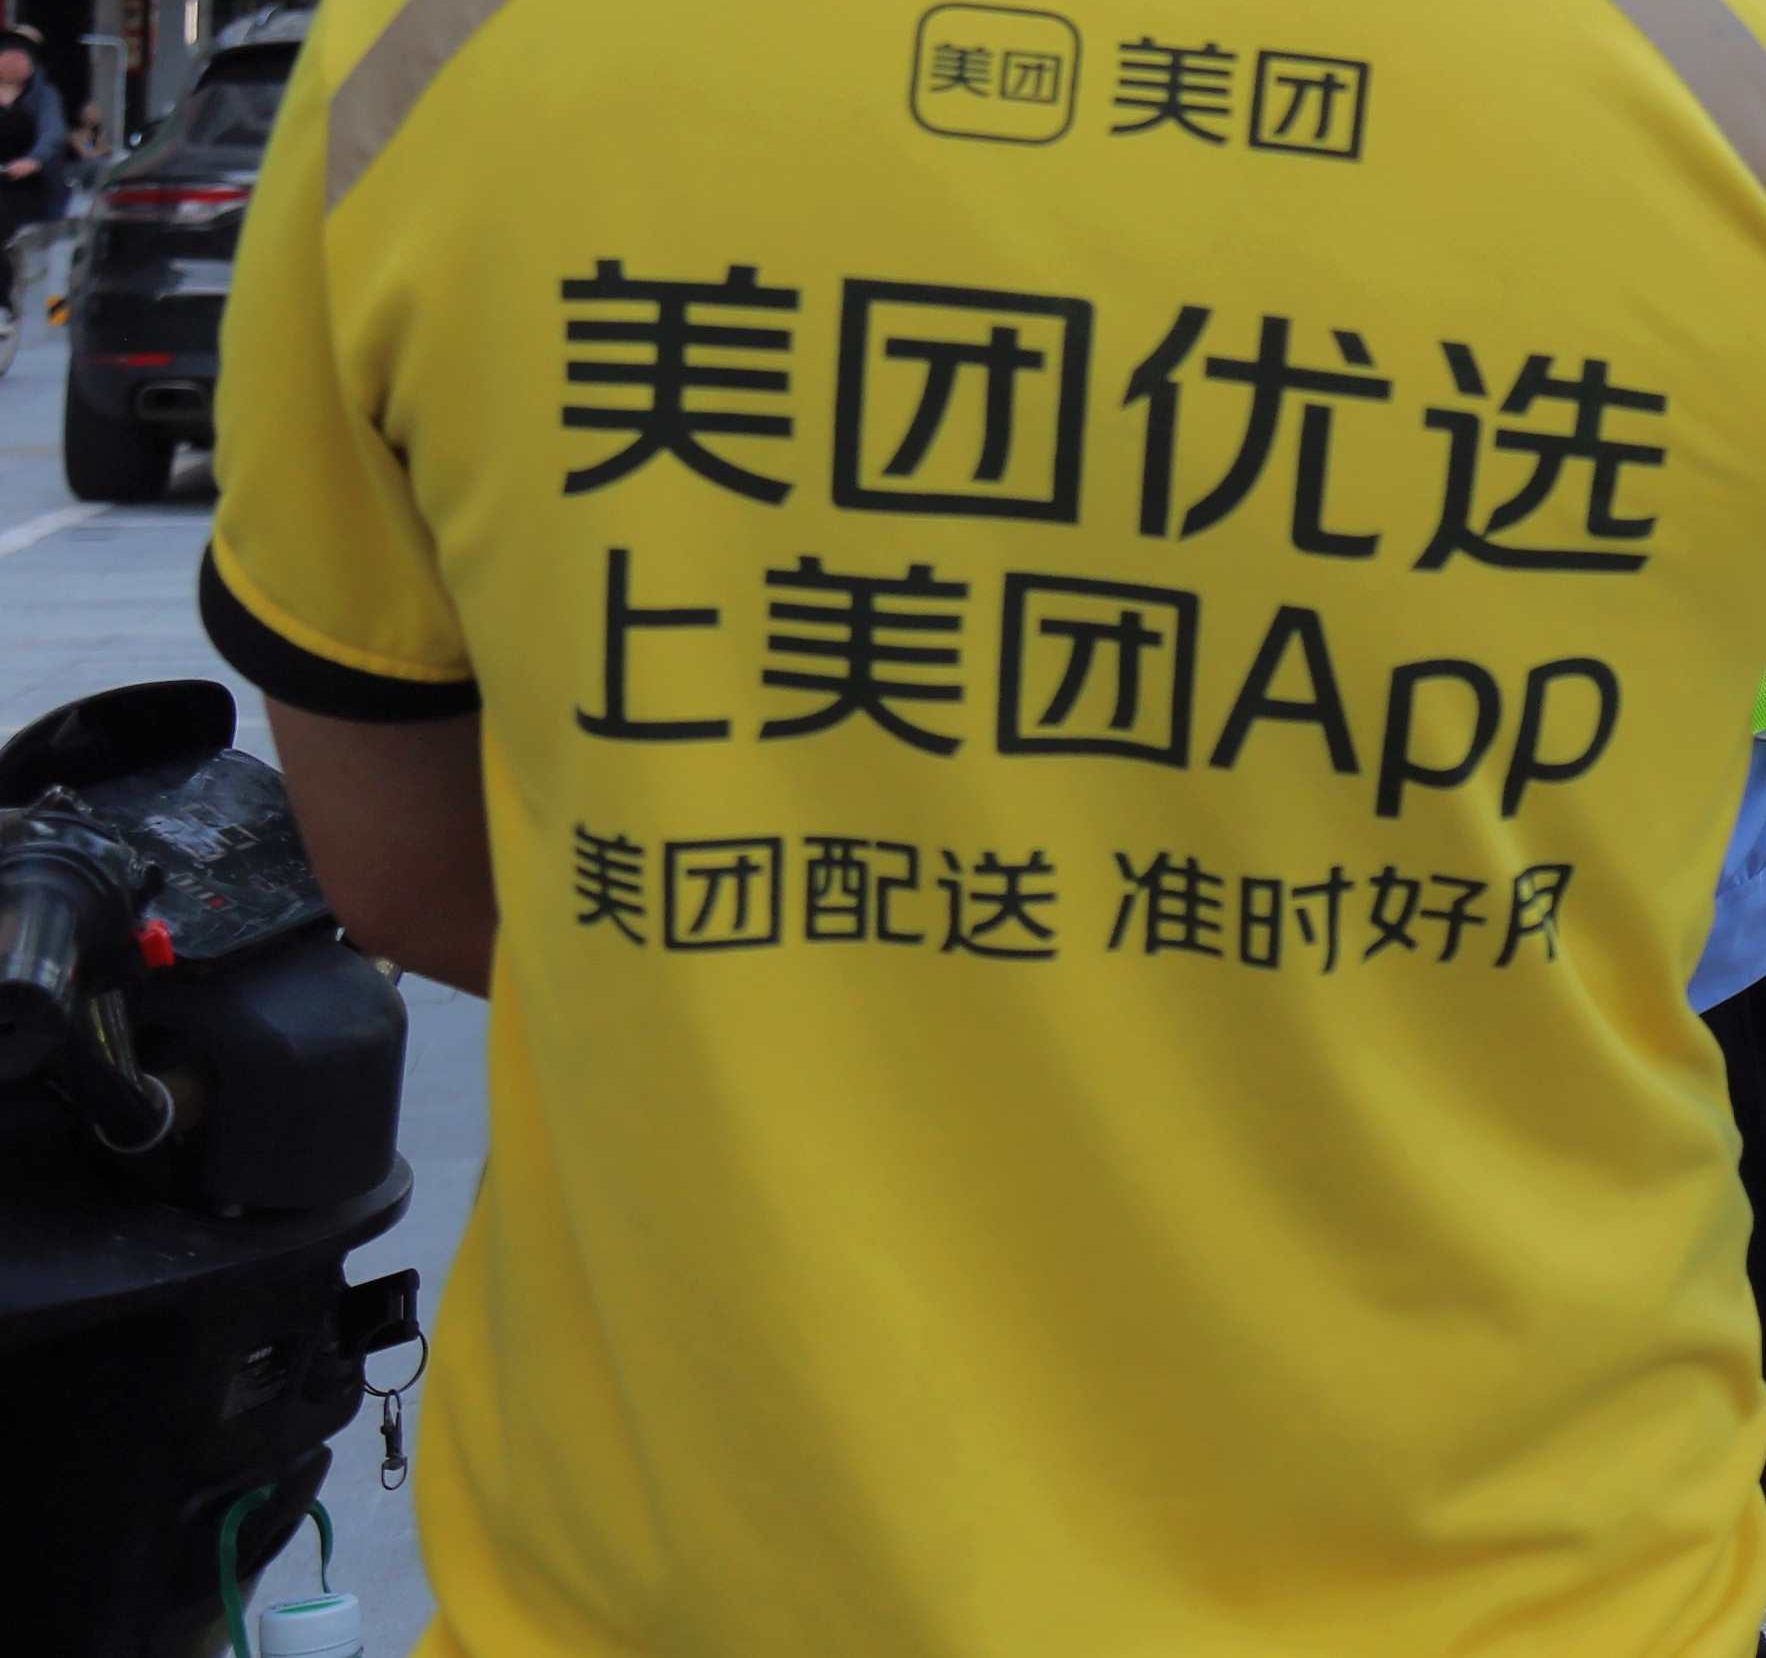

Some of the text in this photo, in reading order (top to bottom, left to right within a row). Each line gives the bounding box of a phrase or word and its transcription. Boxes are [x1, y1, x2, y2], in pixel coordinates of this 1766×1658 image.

[929, 42, 1063, 105] 美团
[1108, 35, 1373, 163] 美团
[559, 259, 1669, 574] 美团优选
[574, 548, 1621, 820] 上美团App
[573, 820, 1060, 960] 美团配送
